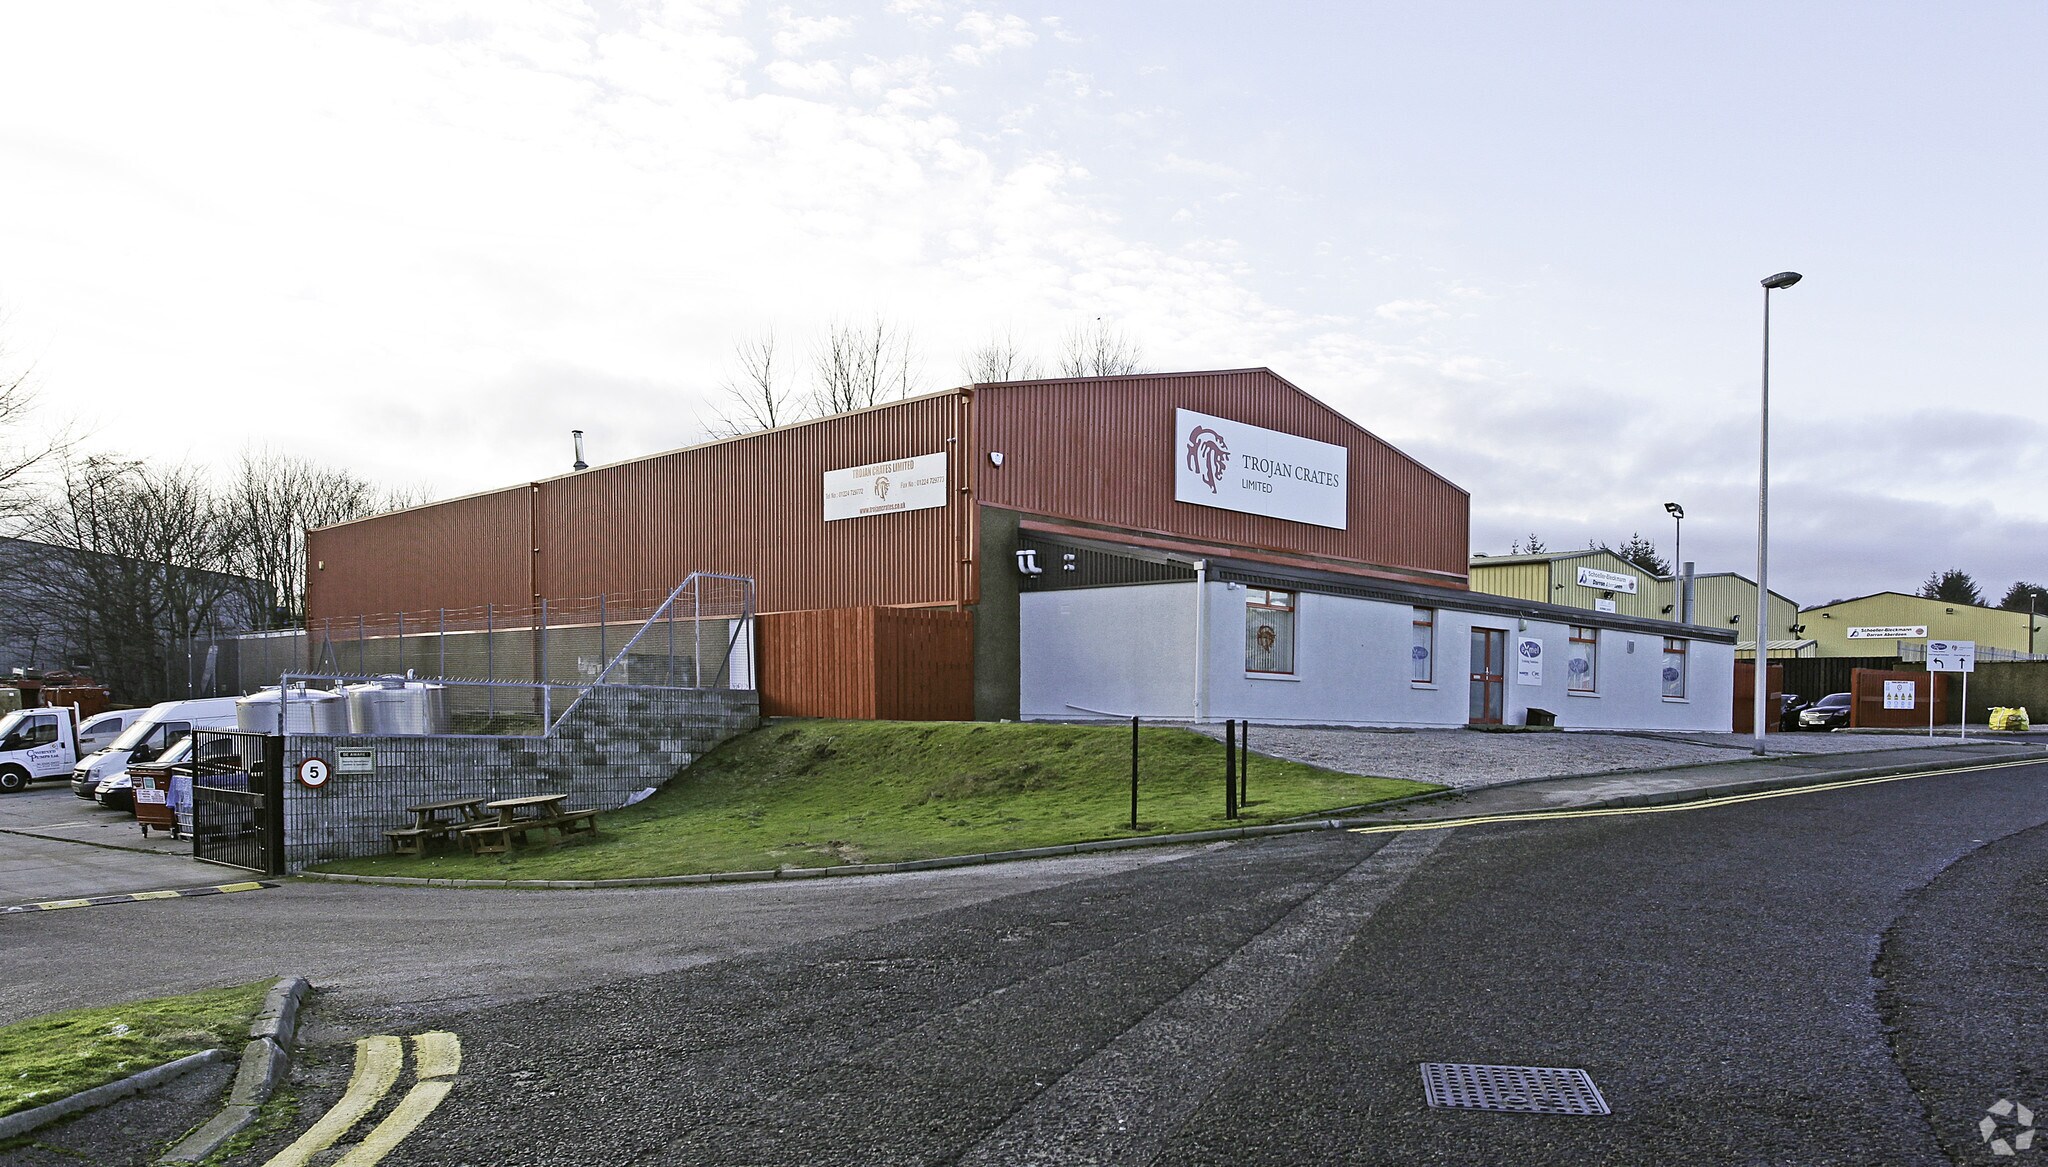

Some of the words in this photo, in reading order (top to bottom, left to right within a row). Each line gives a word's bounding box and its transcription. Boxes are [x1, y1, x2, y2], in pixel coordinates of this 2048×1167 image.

[852, 467, 872, 479] TROJAN
[872, 463, 892, 476] CRATES
[892, 460, 915, 472] LIMITED
[1242, 454, 1292, 478] TROJAN
[1295, 466, 1339, 488] CRATES
[1242, 478, 1273, 494] LIMITED
[309, 766, 319, 779] 5
